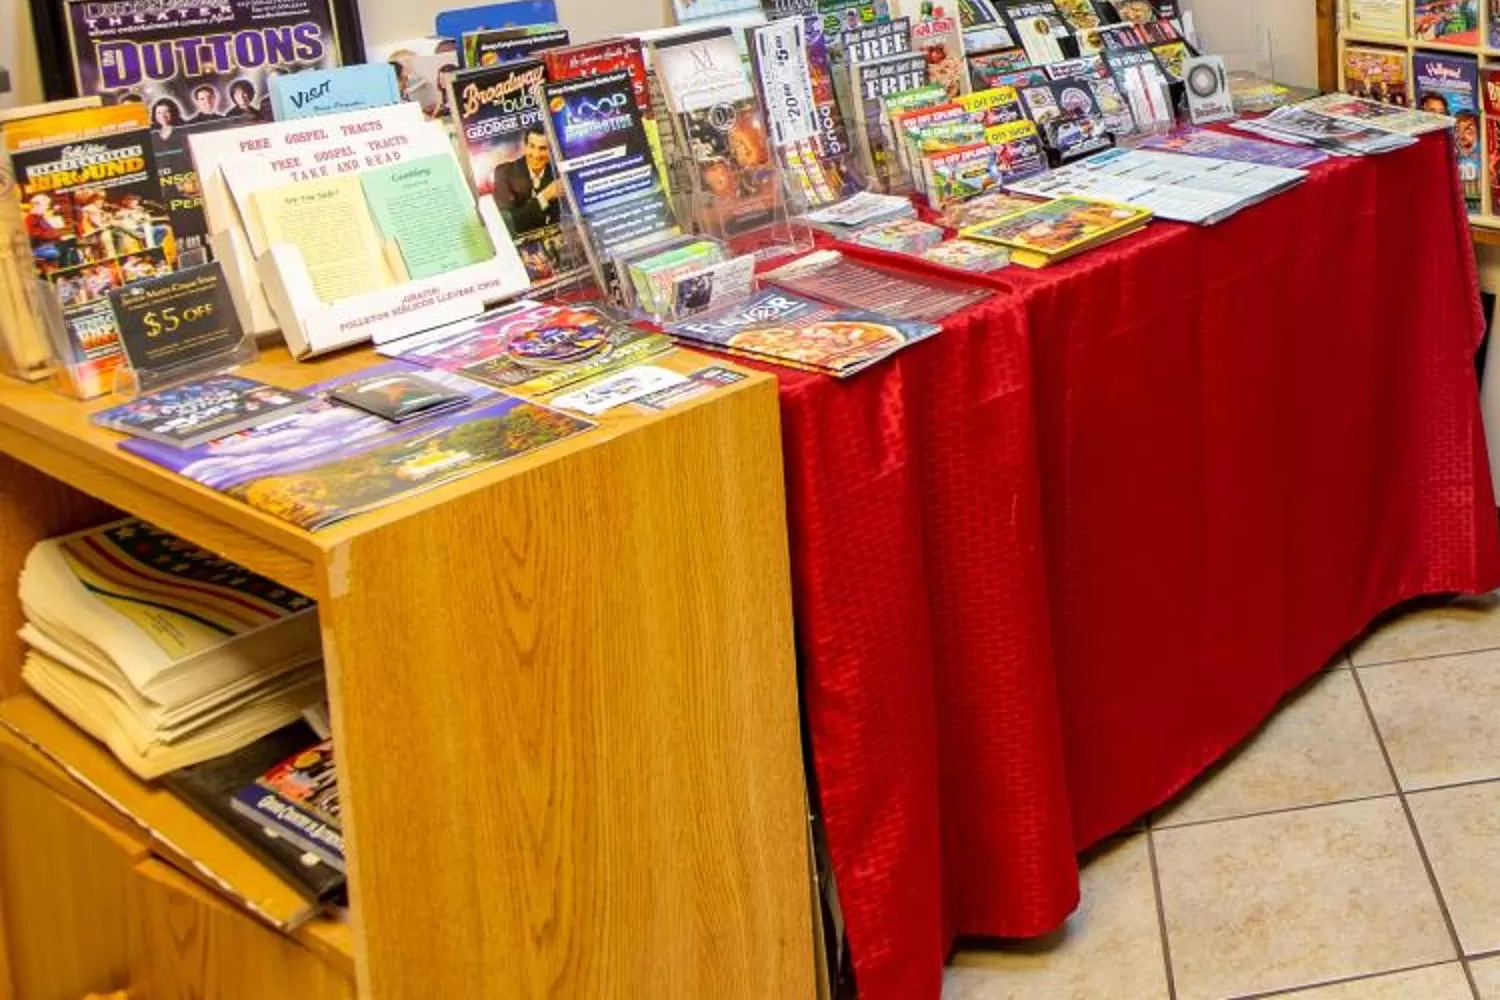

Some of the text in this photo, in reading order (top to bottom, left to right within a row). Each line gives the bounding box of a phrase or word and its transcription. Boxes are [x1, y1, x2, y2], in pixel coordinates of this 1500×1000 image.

[86, 5, 233, 28] THEATER
[99, 22, 325, 90] DUTTONS
[848, 31, 909, 64] FREE
[463, 64, 545, 119] Broadway
[864, 70, 926, 100] FREE
[238, 119, 384, 153] FREE GOSPEL TRACTS
[271, 134, 409, 173] FREE GOSPEL TRACTS
[290, 150, 403, 183] TAKE AND READ
[143, 303, 214, 338] $5 OFF
